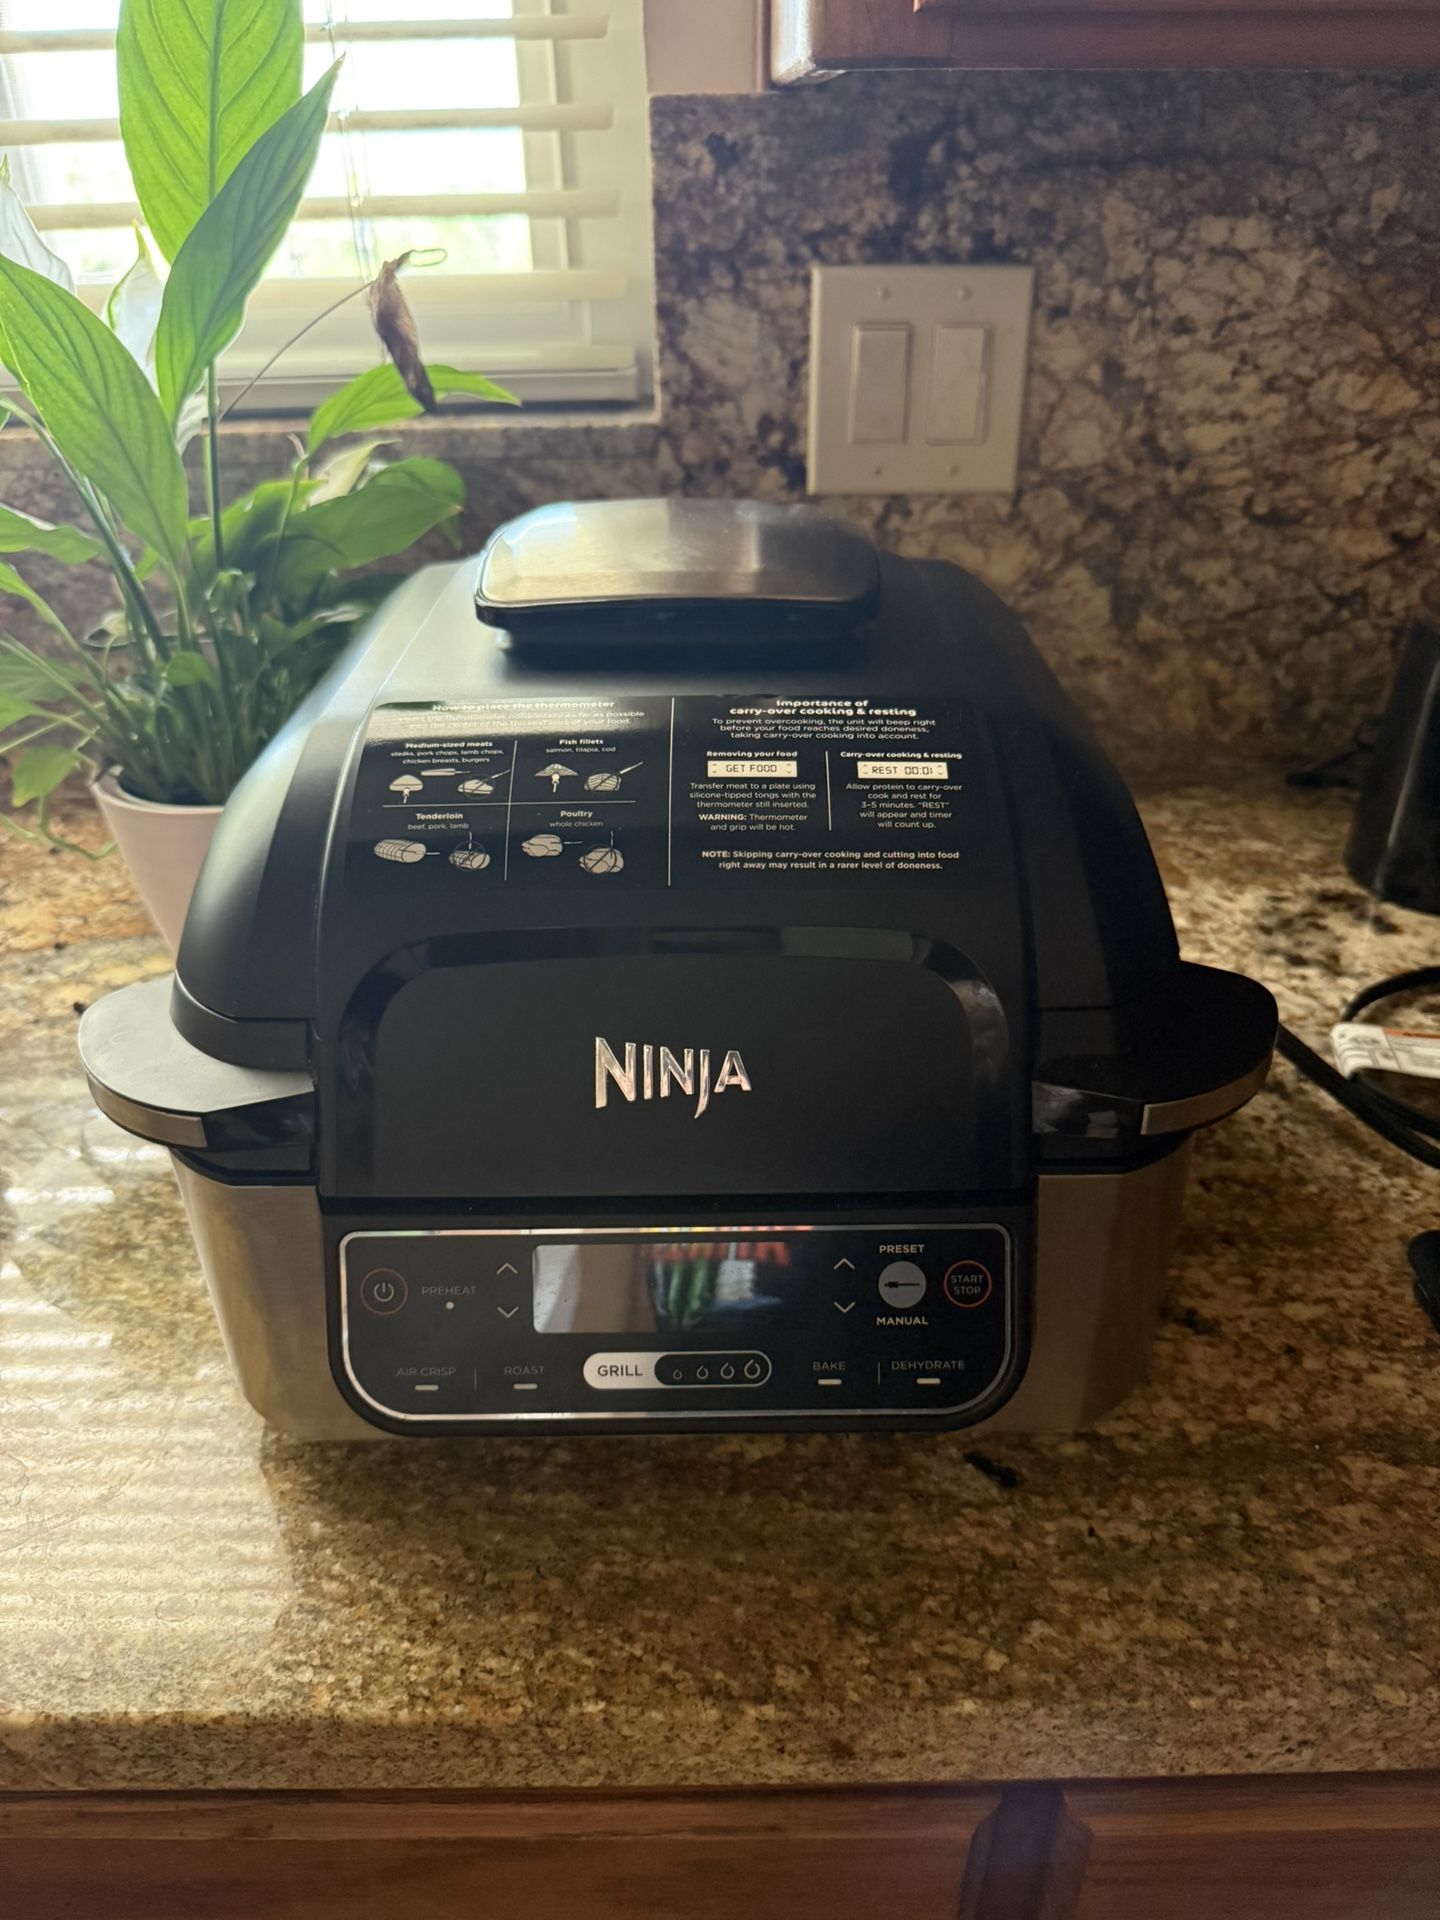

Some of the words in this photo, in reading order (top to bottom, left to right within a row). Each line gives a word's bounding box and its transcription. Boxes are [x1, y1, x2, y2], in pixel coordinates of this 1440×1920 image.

[477, 703, 510, 711] place
[776, 700, 852, 708] Importance
[729, 708, 796, 716] carry-over
[799, 707, 854, 716] cooking
[869, 708, 917, 717] resting
[583, 718, 604, 726] your
[886, 751, 922, 759] cooking
[931, 752, 962, 760] resting
[726, 764, 746, 773] GET
[749, 764, 777, 773] FOOD
[871, 766, 898, 774] REST
[690, 782, 724, 790] Transfer
[769, 783, 791, 791] plate
[754, 792, 779, 800] tongs
[560, 810, 593, 818] Poultry
[729, 824, 747, 832] grip
[749, 823, 764, 831] will
[779, 823, 796, 831] hot.
[733, 851, 773, 859] Skipping
[775, 851, 822, 859] carry-over
[824, 851, 861, 859] cooking
[882, 851, 915, 859] cutting
[719, 861, 740, 869] right
[790, 861, 816, 869] result
[861, 861, 883, 869] level
[595, 1036, 752, 1119] NINJA
[878, 1244, 925, 1254] PRESET
[951, 1274, 984, 1284] START
[421, 1285, 478, 1296] PREHEAT
[953, 1285, 981, 1295] STOP
[876, 1316, 929, 1326] MANUAL
[813, 1361, 846, 1371] BAKE
[891, 1360, 966, 1370] DEHYDRATE
[396, 1367, 418, 1377] AIR
[420, 1367, 456, 1377] CRISP
[504, 1365, 545, 1376] ROAST
[597, 1364, 643, 1377] GRILL
